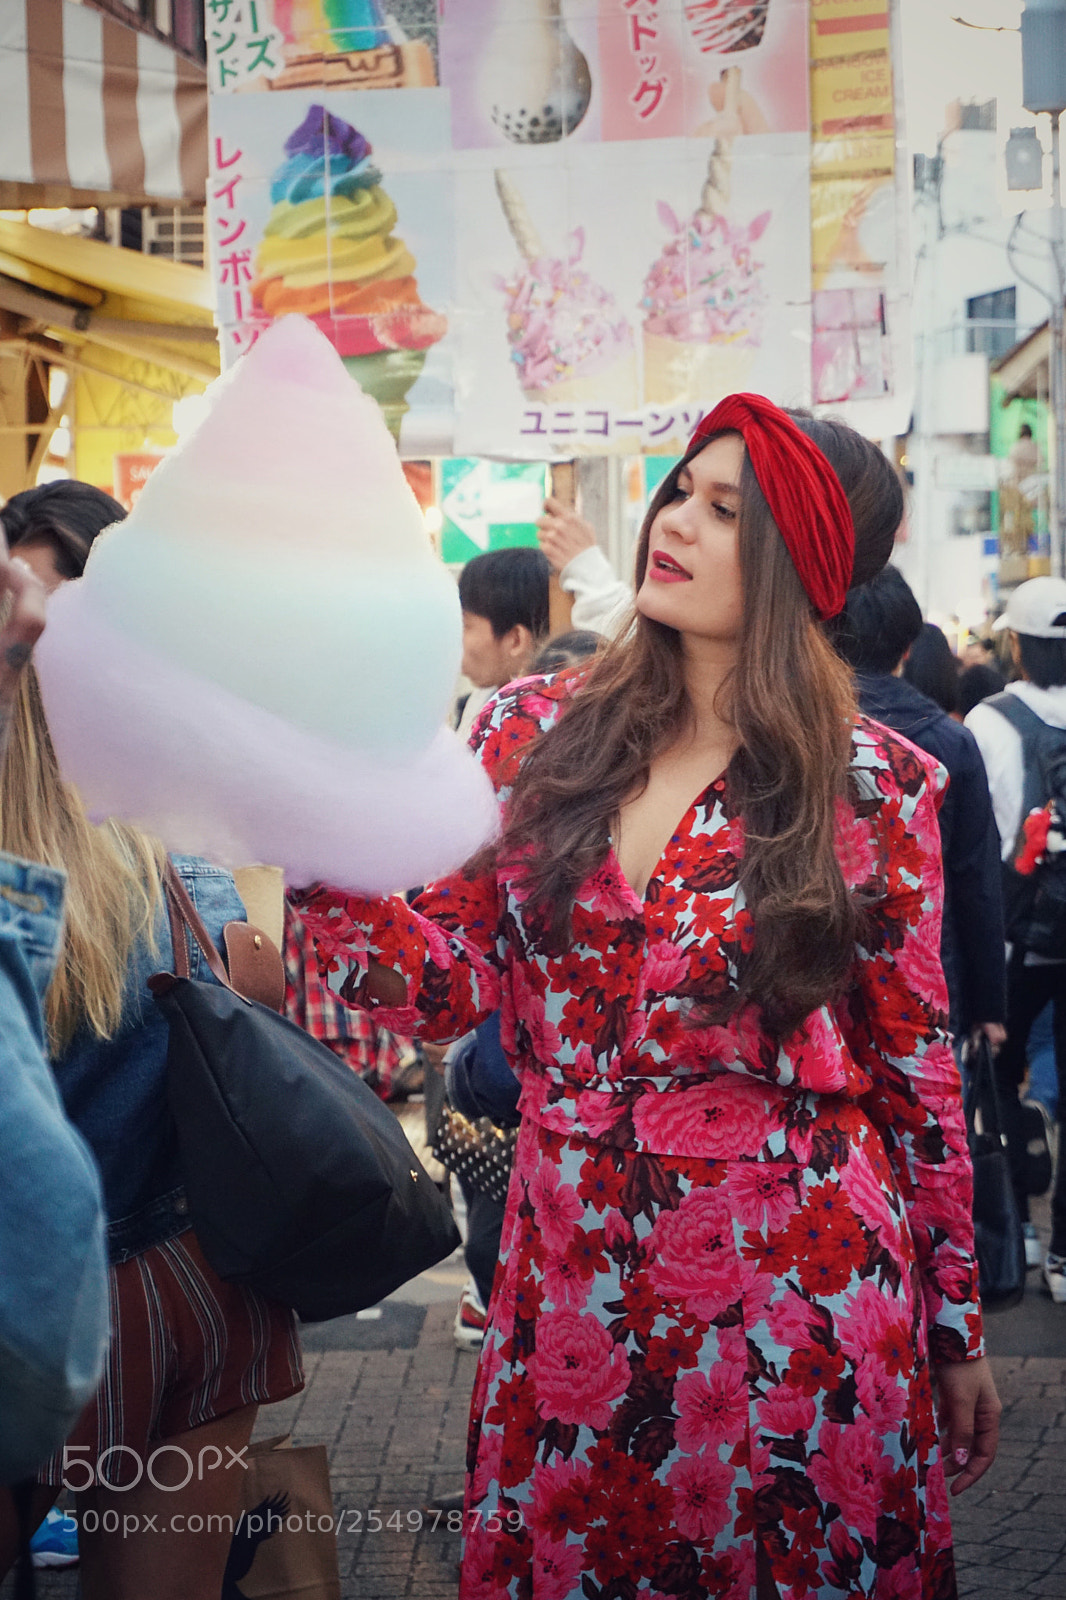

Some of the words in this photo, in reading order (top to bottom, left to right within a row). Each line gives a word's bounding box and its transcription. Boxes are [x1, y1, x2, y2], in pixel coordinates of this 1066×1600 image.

[624, 0, 668, 118] ドッグ
[832, 85, 889, 103] CREAM
